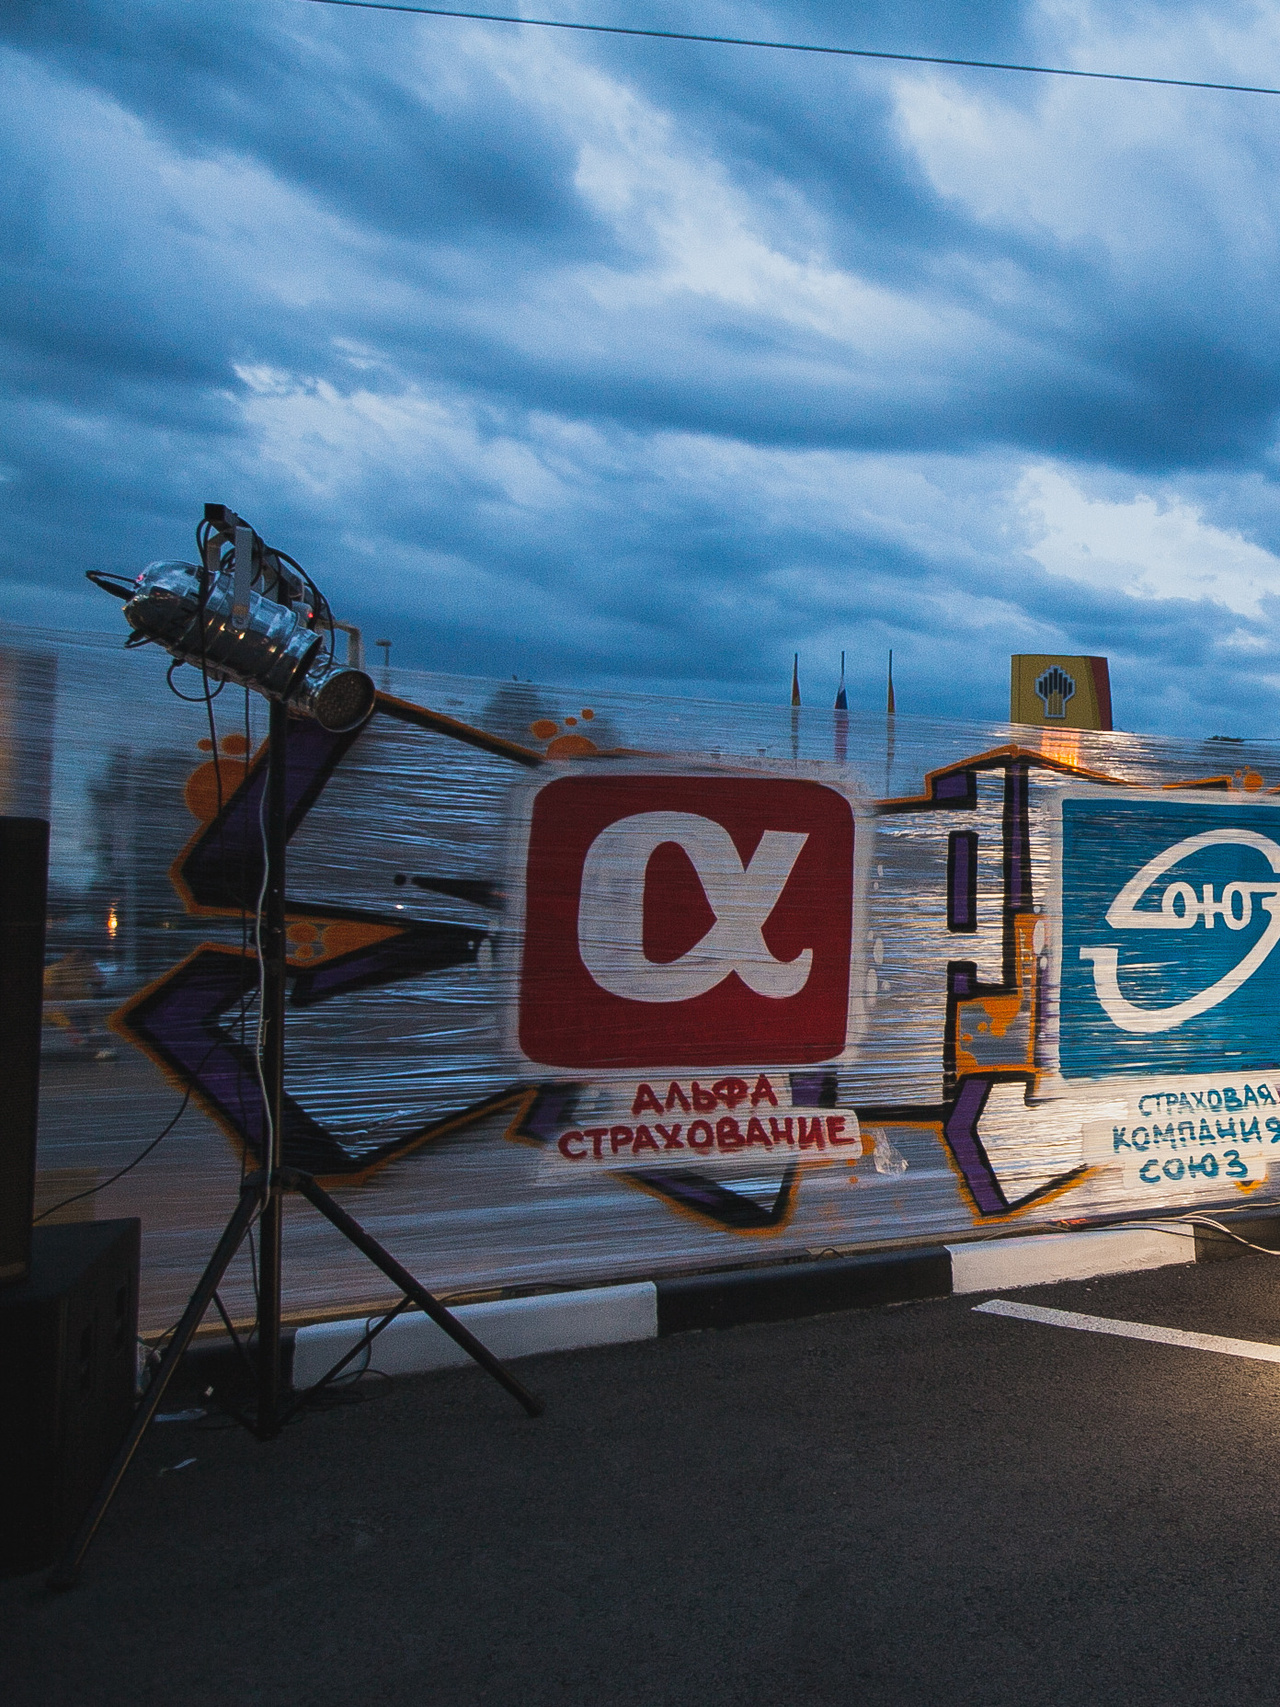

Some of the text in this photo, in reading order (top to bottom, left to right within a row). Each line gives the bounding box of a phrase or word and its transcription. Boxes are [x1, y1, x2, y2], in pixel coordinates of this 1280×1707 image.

[631, 1073, 778, 1115] АЛЬФА
[1138, 1083, 1277, 1117] СТРАХОВАЯ
[558, 1116, 855, 1160] СТРАХОВАНИЕ
[1139, 1149, 1249, 1183] СОЮЗ
